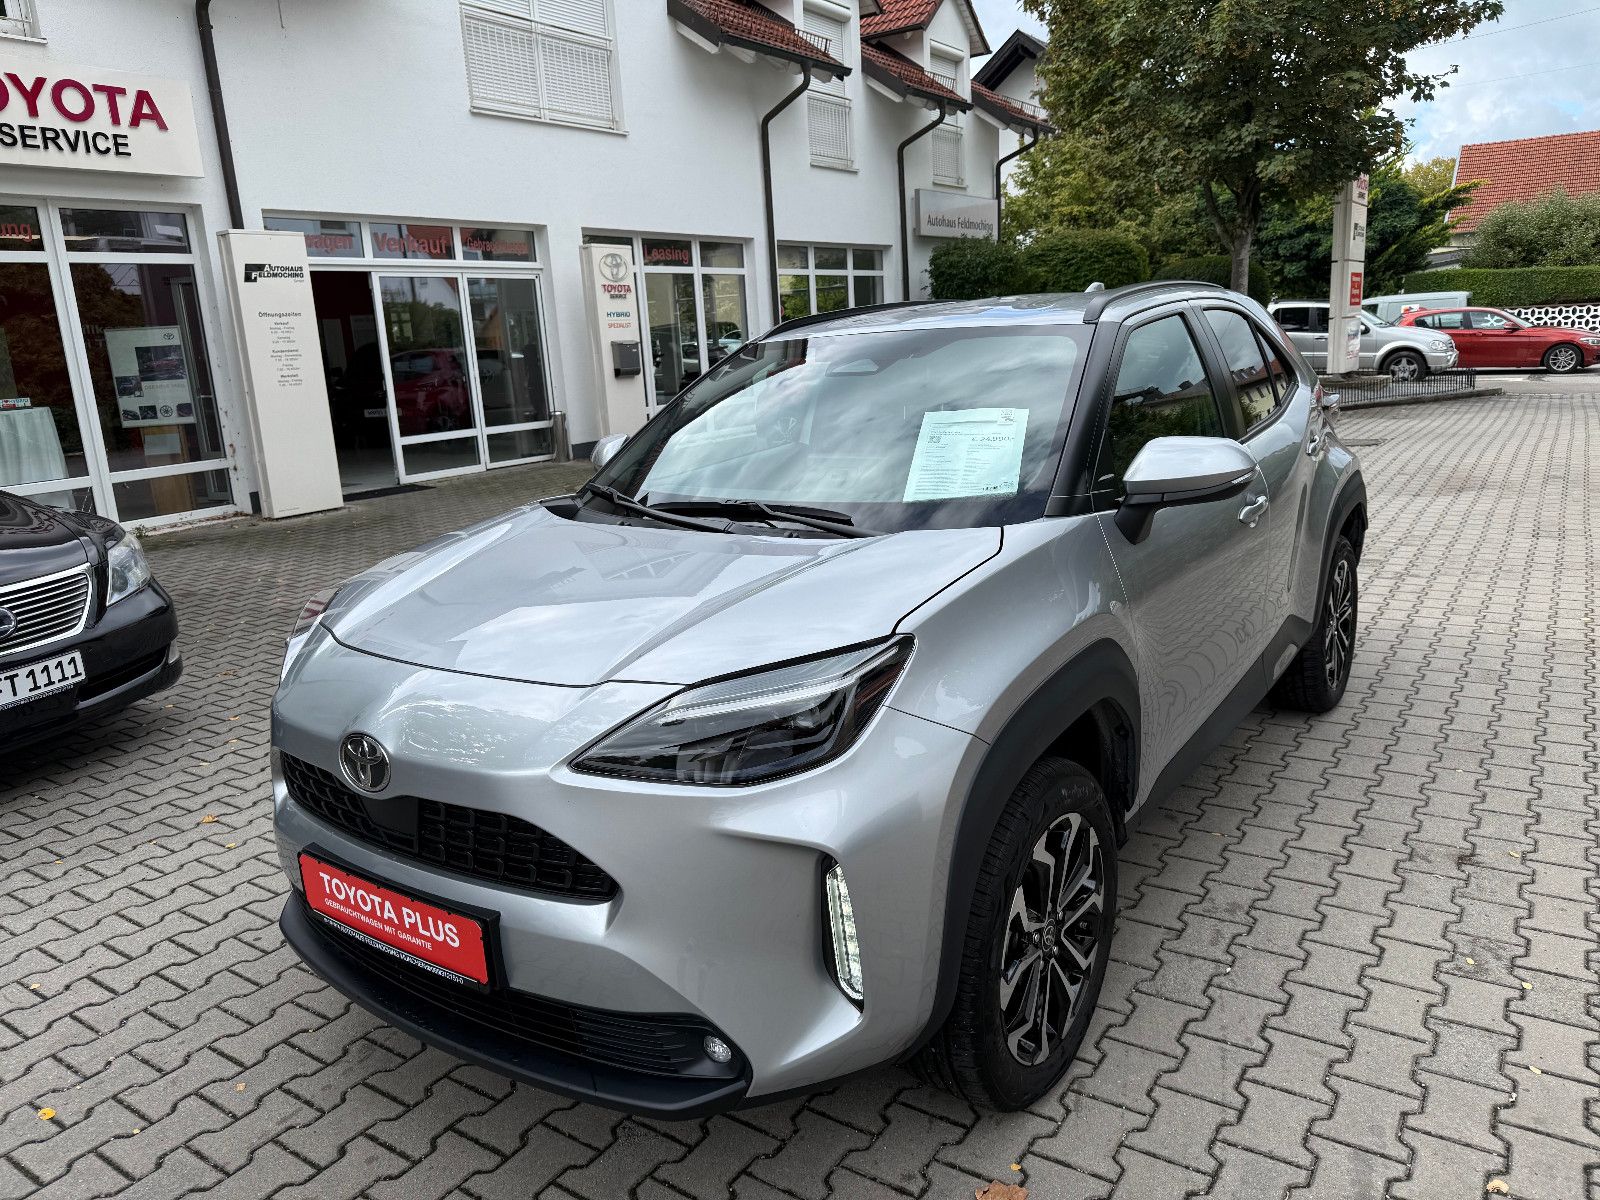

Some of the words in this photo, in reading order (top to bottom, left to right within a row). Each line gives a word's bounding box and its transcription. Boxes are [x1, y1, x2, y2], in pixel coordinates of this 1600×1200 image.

[0, 72, 169, 131] YOTA
[0, 123, 132, 157] SERVICE
[927, 213, 957, 229] Autohaus
[958, 217, 994, 234] Feldmoching
[373, 232, 448, 255] Verkauf
[644, 245, 689, 264] Leasing
[264, 264, 303, 272] AUTOHAUS
[601, 284, 632, 293] TOYOTA
[258, 311, 302, 319] Öffnungszeiten
[0, 673, 20, 697] T
[26, 656, 82, 692] 1111
[319, 872, 400, 925] TOYOTA
[402, 906, 460, 948] PLUS
[324, 898, 383, 931] GEBRAUCHTWAGEN
[384, 924, 396, 936] MIT
[397, 930, 433, 951] GARANTIE
